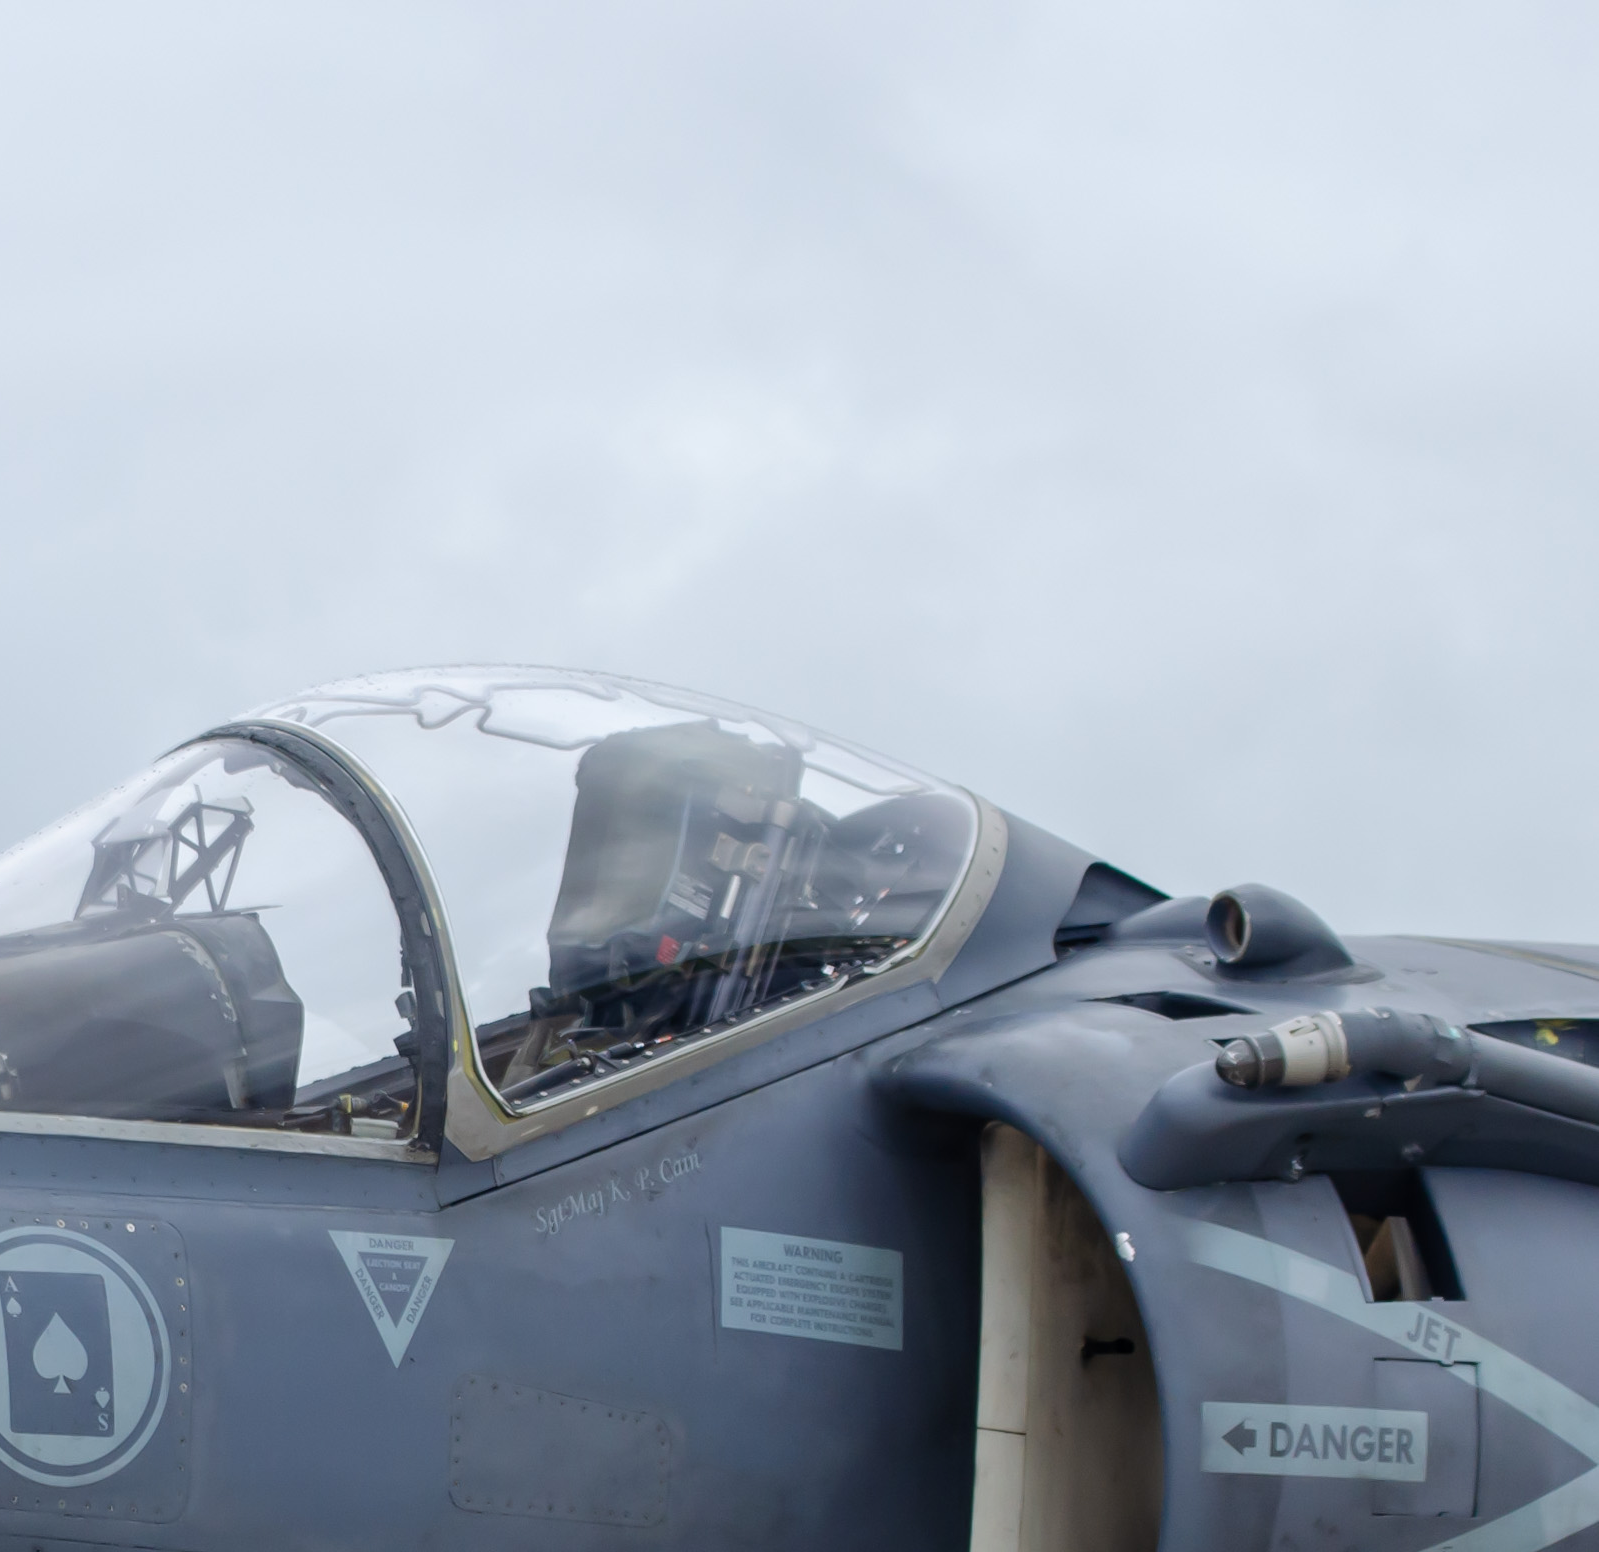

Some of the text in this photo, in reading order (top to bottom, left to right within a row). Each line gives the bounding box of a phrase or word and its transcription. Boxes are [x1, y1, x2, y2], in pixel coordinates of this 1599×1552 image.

[535, 1185, 603, 1235] SgtMaj
[659, 1152, 701, 1184] Cain
[369, 1238, 414, 1251] DANGER
[783, 1243, 843, 1264] WARNING
[366, 1258, 421, 1270] EJECTION SEAT
[731, 1256, 750, 1268] THIS
[752, 1260, 793, 1274] AIRCRAFT
[795, 1265, 837, 1280] CONTAINS
[839, 1271, 846, 1281] A
[4, 1275, 19, 1293] A
[355, 1268, 386, 1321] DANGER
[379, 1282, 410, 1293] CANOPY
[733, 1272, 775, 1285] ACTUATED
[777, 1276, 828, 1291] EMERGENCY
[830, 1283, 859, 1296] ESCAPE
[736, 1284, 776, 1298] EQUIPPED
[779, 1290, 801, 1302] WITH
[803, 1293, 847, 1308] EXPLOSIVE
[406, 1275, 433, 1325] DANGER
[729, 1296, 744, 1308] SEE
[747, 1299, 794, 1314] APPLICABLE
[797, 1307, 858, 1322] MAINTENANCE
[750, 1313, 767, 1324] FOR
[770, 1315, 812, 1330] COMPLETE
[1407, 1312, 1462, 1360] JET
[97, 1413, 110, 1431] S
[1270, 1422, 1415, 1465] DANGER
